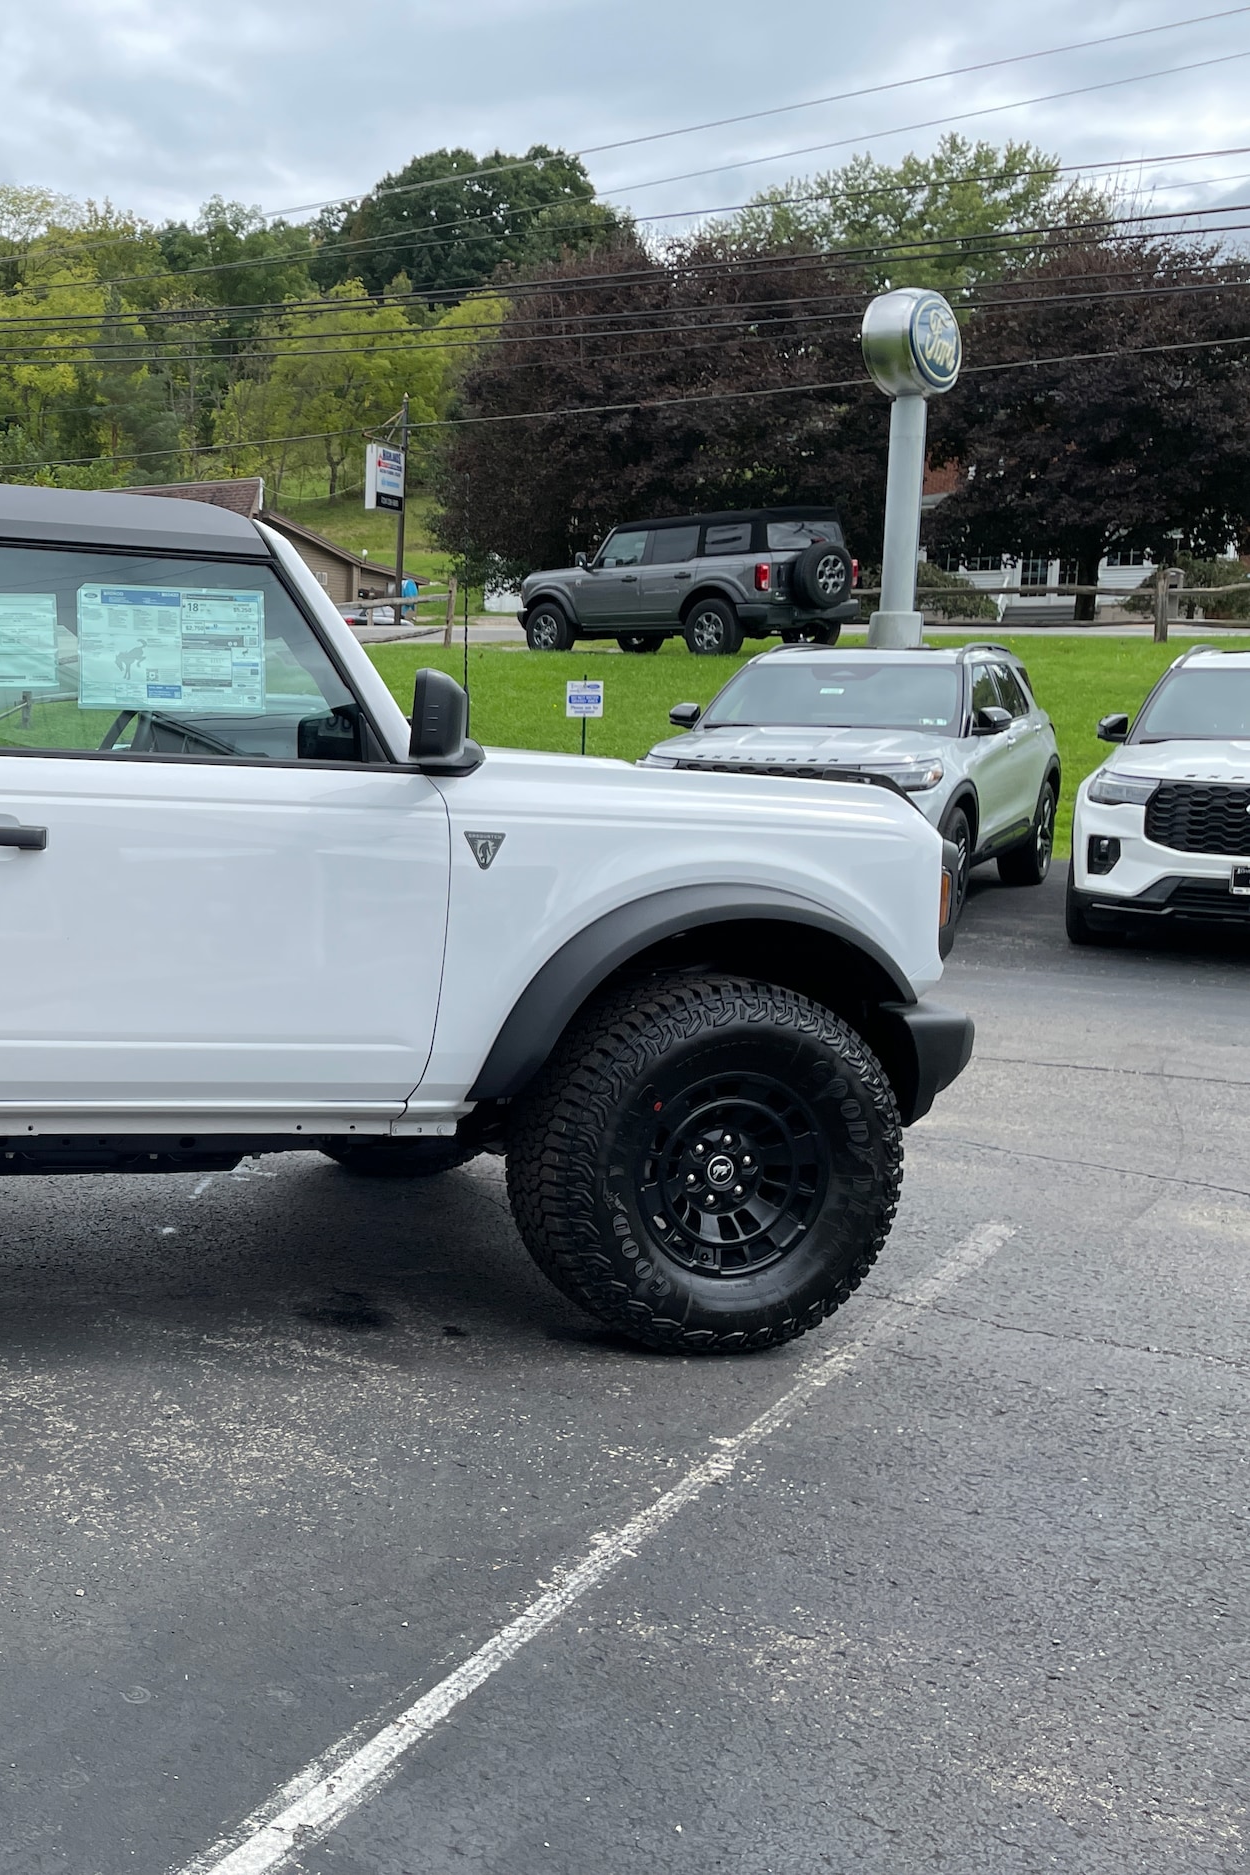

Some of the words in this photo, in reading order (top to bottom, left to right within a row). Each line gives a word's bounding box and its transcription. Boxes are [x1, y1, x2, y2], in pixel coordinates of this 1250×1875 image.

[924, 309, 958, 373] Ford
[187, 603, 199, 612] 18
[695, 754, 839, 763] EXPLORER
